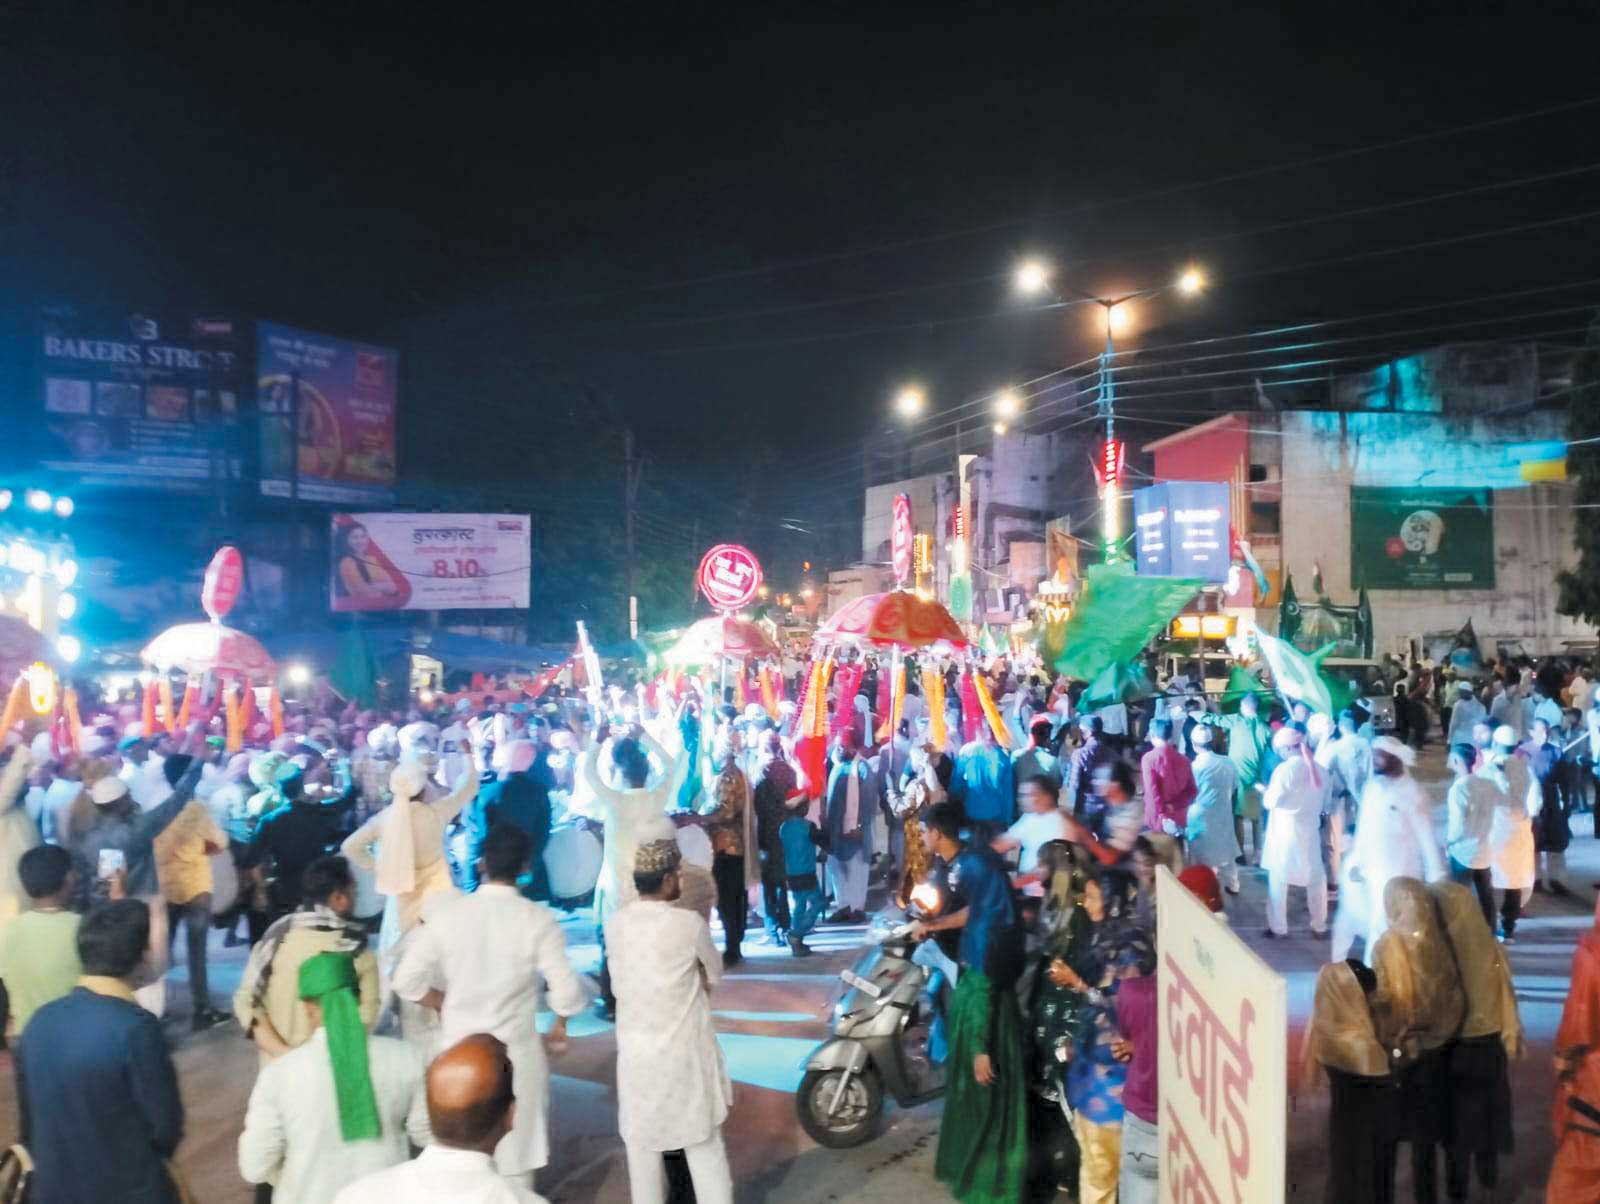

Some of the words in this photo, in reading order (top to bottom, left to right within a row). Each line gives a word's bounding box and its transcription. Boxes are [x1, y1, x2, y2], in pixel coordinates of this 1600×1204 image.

[45, 336, 142, 364] BAKERS
[149, 345, 235, 369] STRT
[1165, 950, 1256, 1203] दवाई
